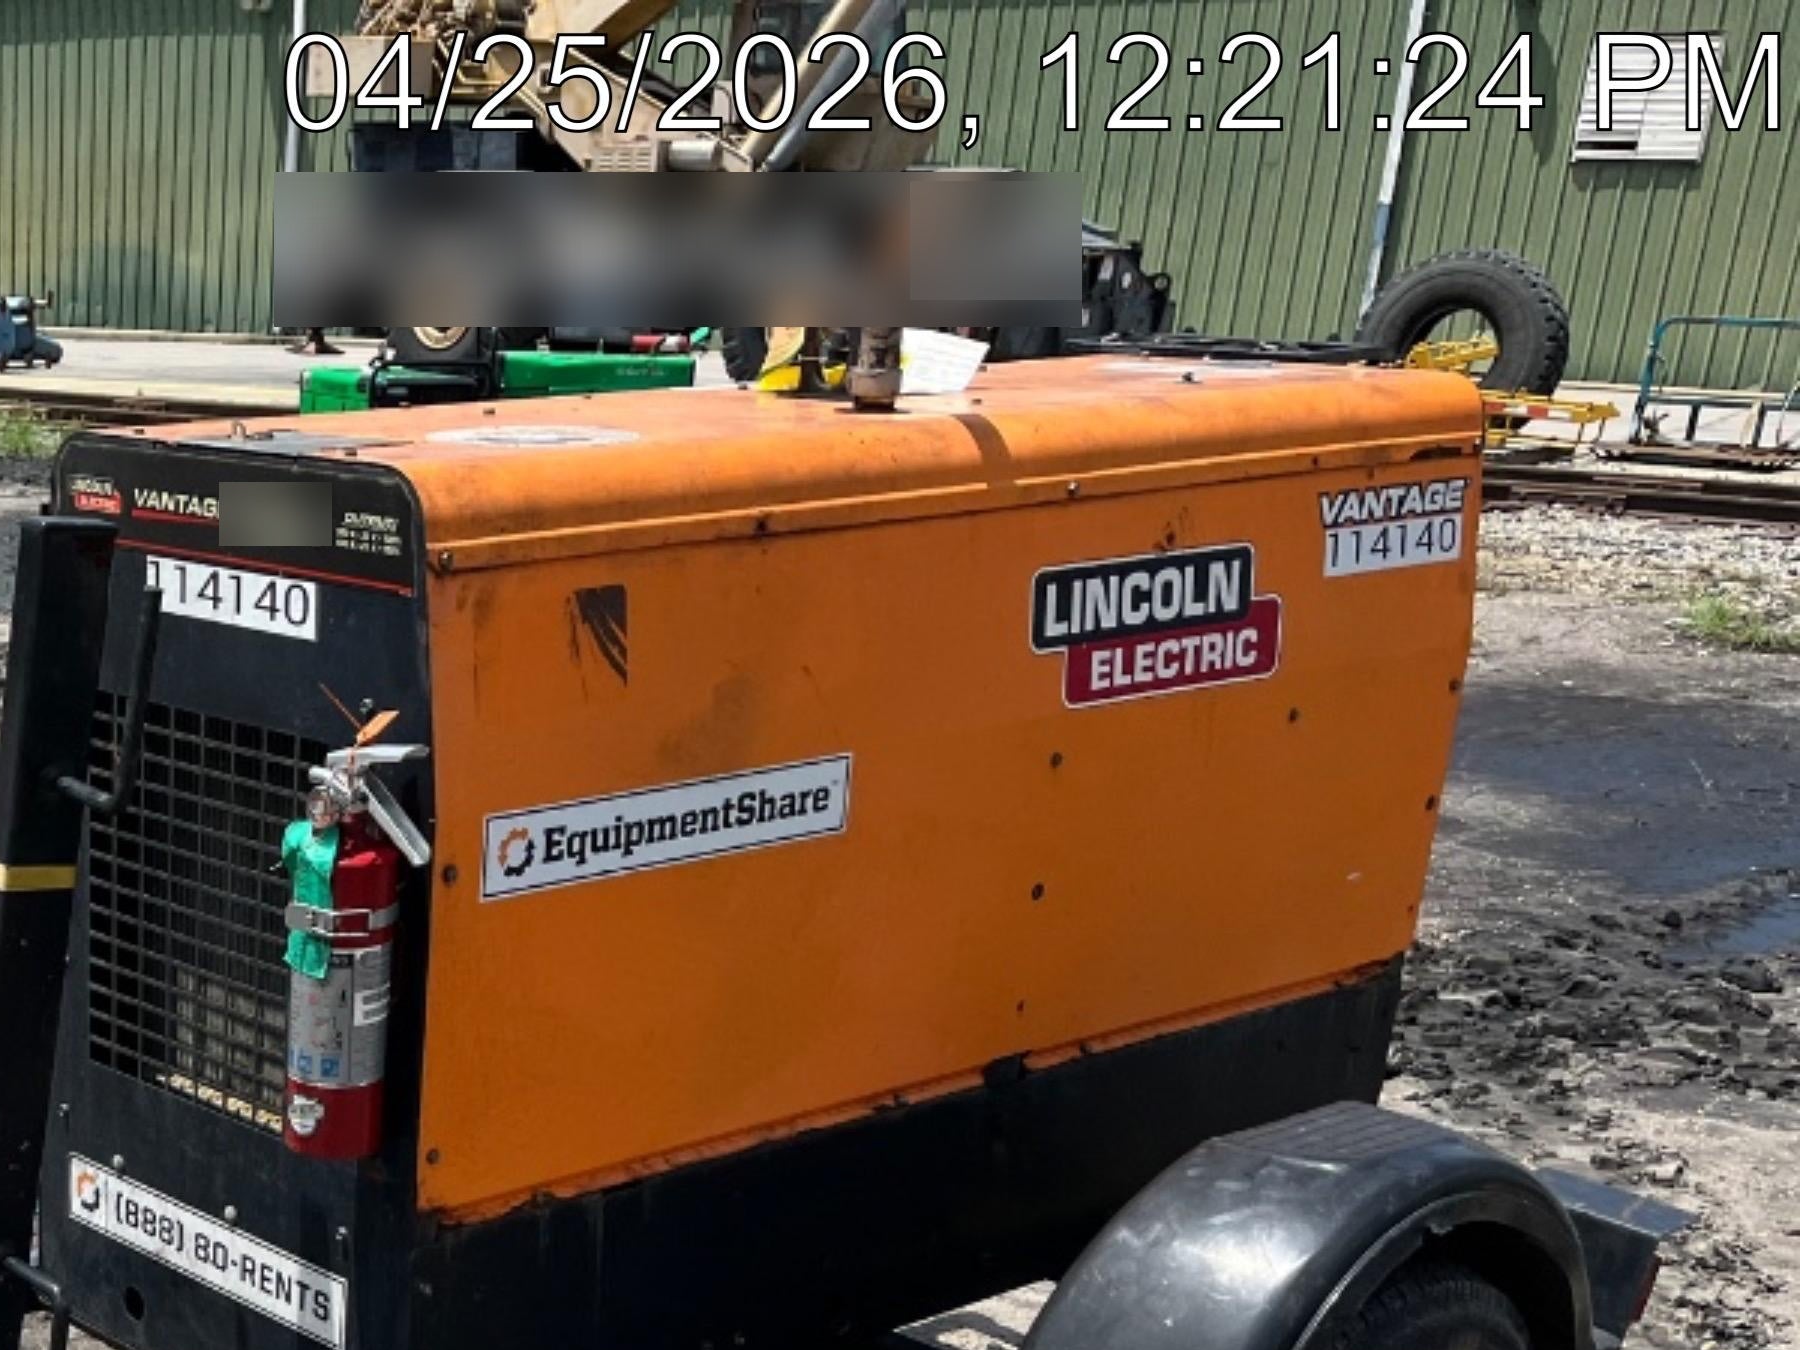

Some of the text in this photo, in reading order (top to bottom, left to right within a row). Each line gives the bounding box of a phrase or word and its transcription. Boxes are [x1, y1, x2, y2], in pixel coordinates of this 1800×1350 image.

[132, 487, 219, 519] VANTAG
[1320, 478, 1465, 527] VANTAGE
[1328, 517, 1457, 568] 114140
[1044, 559, 1242, 637] LINCOLN
[1090, 627, 1260, 690] ELECTRIC
[542, 783, 831, 866] EquipmentShare
[114, 1190, 331, 1323] (888) 80-RENTS
